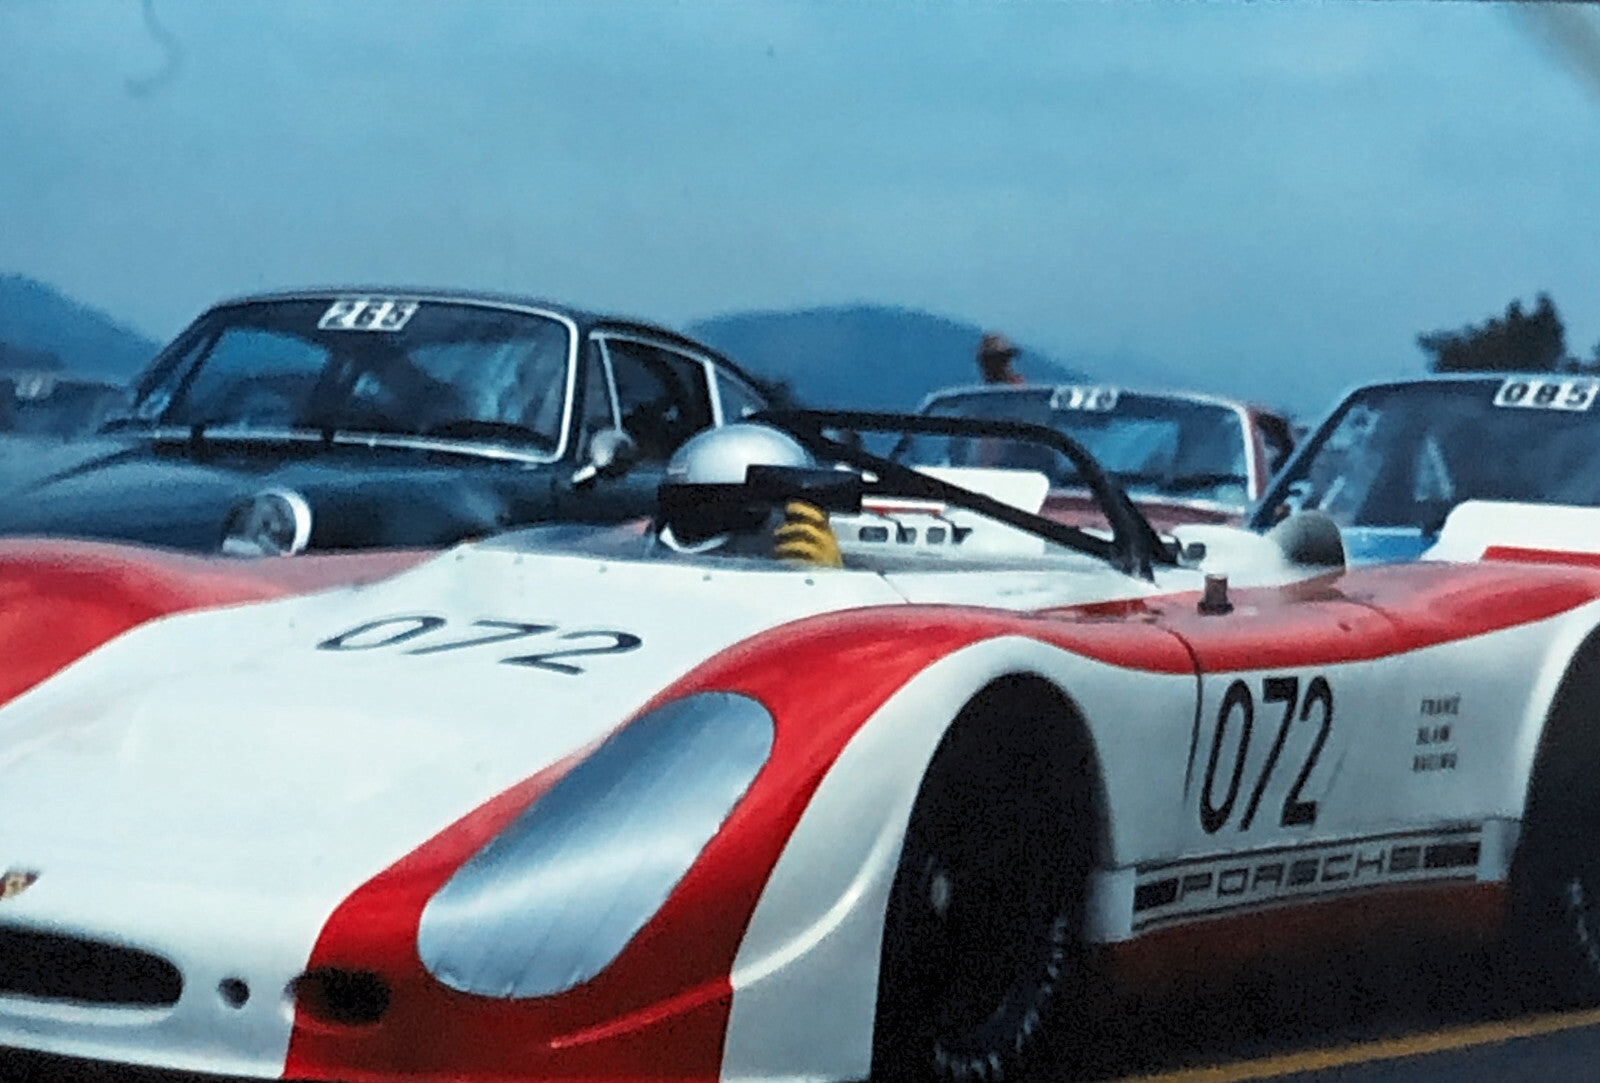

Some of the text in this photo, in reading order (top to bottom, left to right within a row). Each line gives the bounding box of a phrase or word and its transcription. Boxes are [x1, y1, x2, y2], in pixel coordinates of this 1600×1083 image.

[1503, 381, 1592, 406] 085
[317, 616, 643, 675] 072
[1200, 676, 1333, 834] 072
[1180, 845, 1420, 899] PORSCHE
